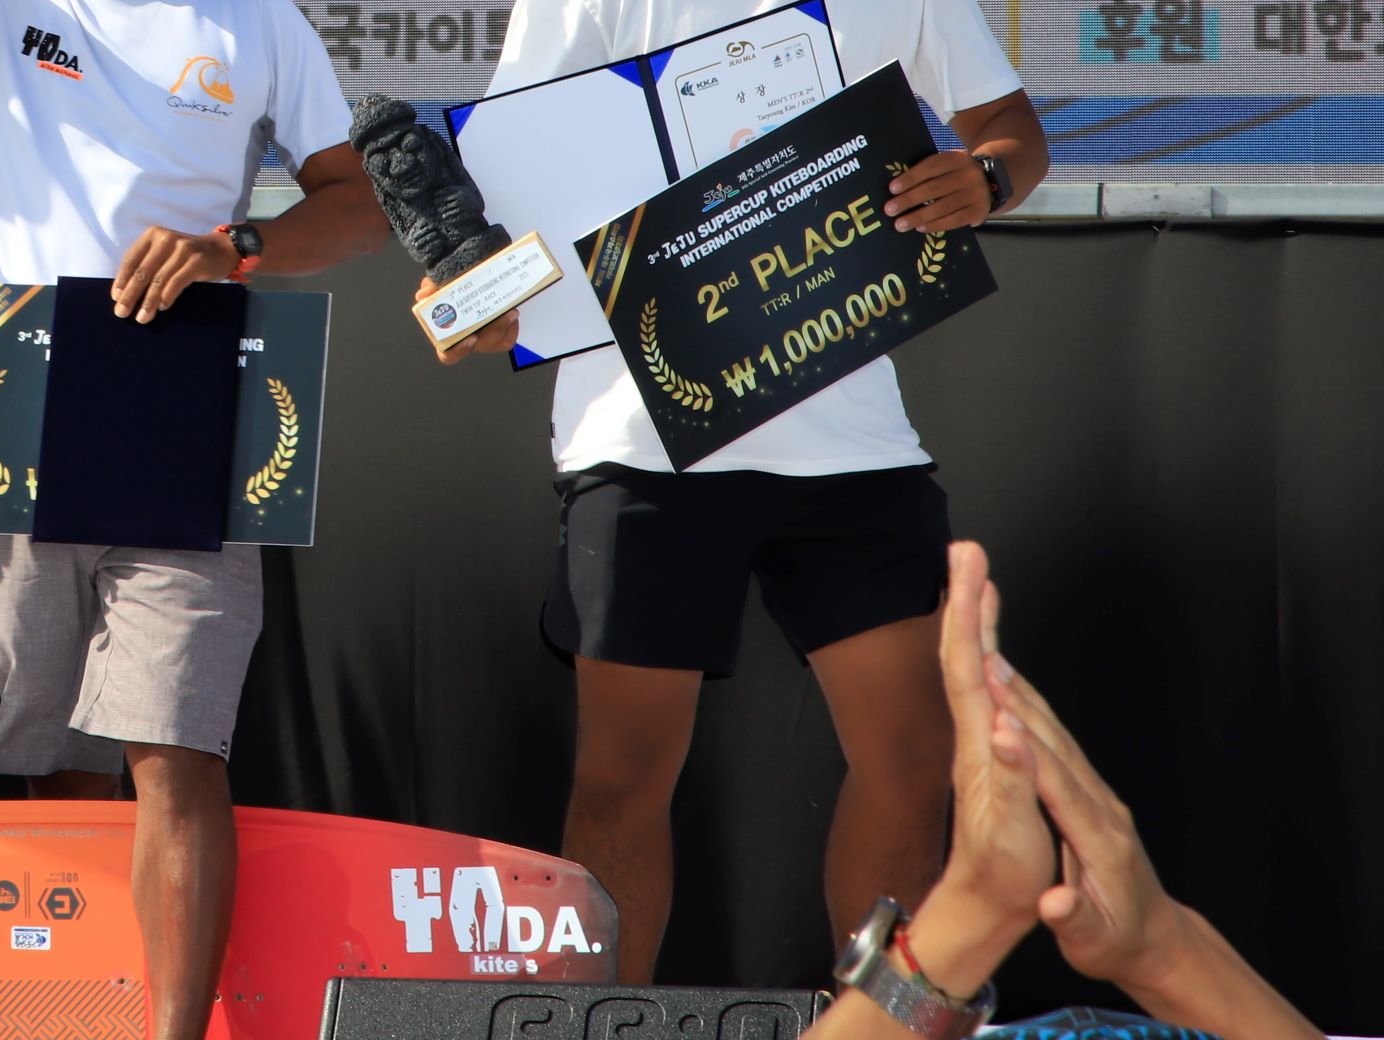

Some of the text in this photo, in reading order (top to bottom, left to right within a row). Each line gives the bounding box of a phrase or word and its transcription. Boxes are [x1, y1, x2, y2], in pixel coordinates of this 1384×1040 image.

[696, 77, 719, 89] KKA
[784, 104, 797, 112] Kim
[736, 144, 797, 183] 제주특별자치도
[647, 250, 660, 265] 3rd
[697, 190, 768, 238] SUPERCUP
[771, 134, 868, 198] KITEBOARDING
[680, 158, 861, 268] INTERNATIONAL COMPETITION
[697, 195, 882, 324] 2nd PLACE
[760, 292, 792, 316] TT:R
[805, 267, 836, 293] MAN
[473, 956, 517, 973] kite
